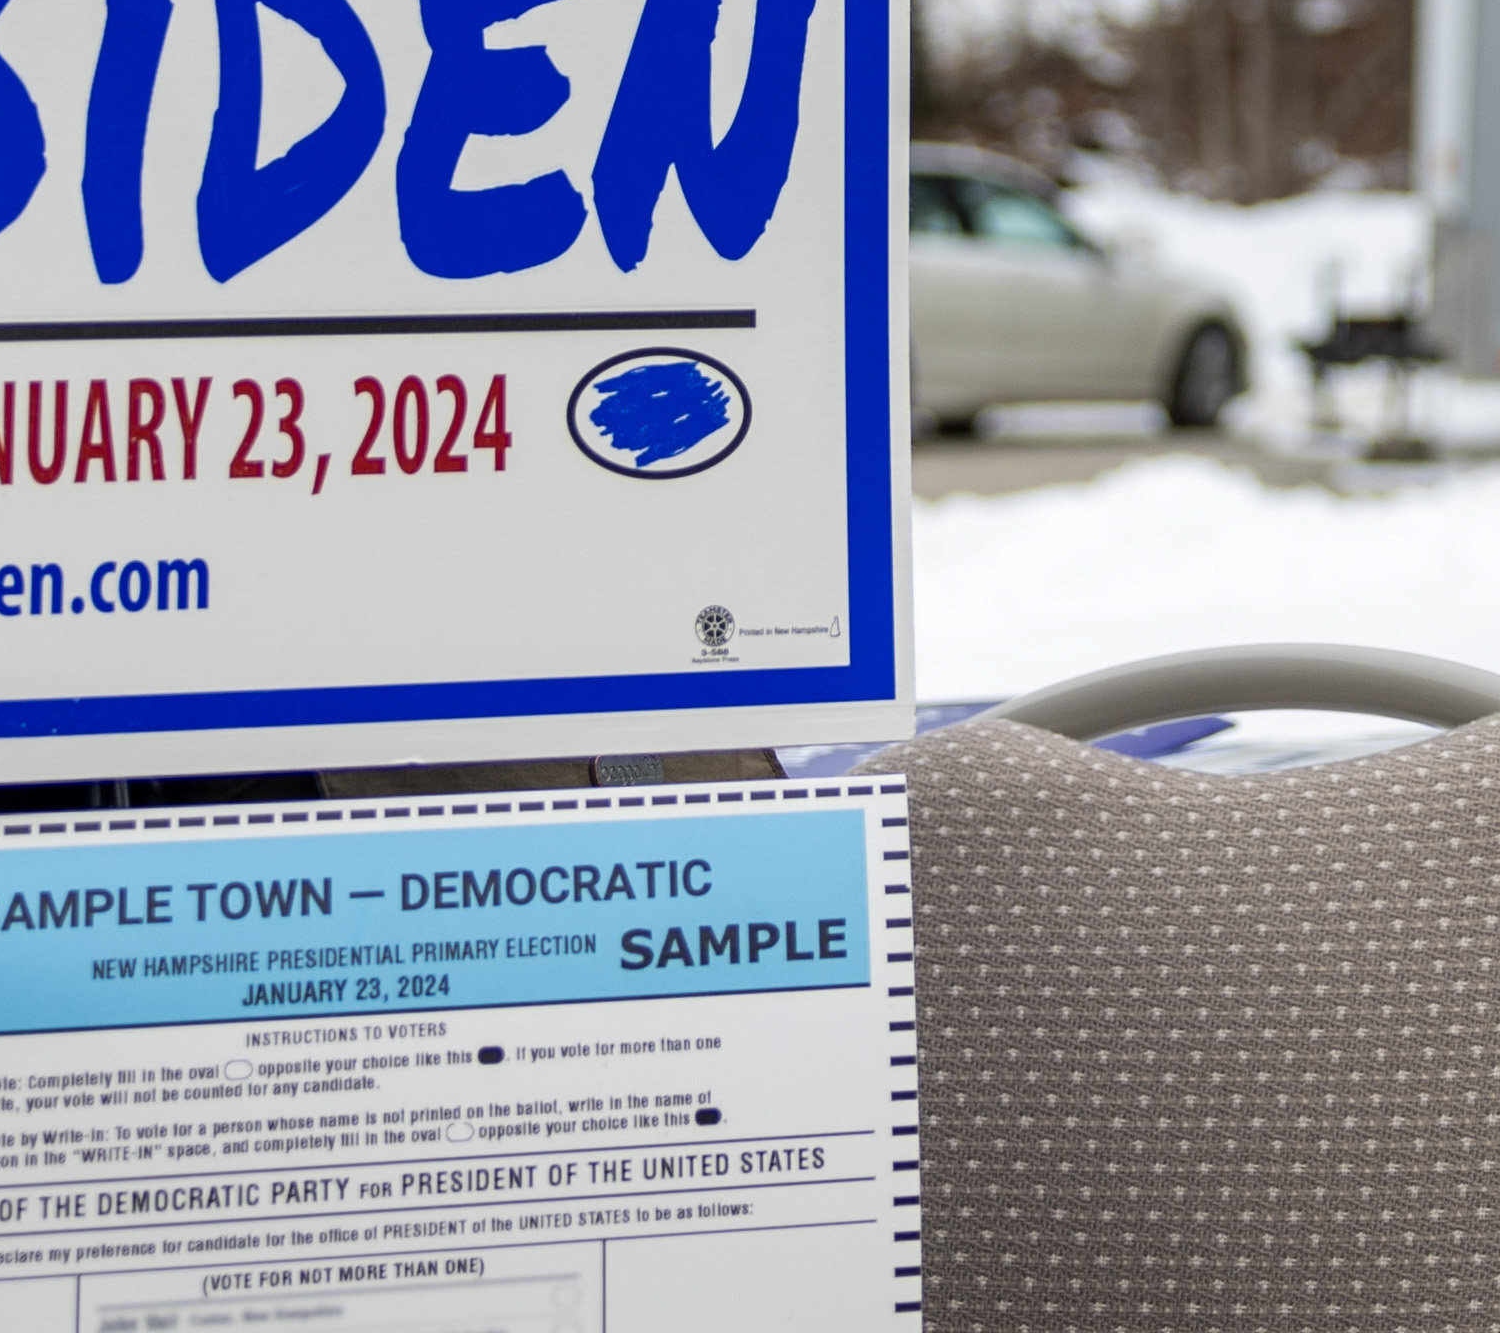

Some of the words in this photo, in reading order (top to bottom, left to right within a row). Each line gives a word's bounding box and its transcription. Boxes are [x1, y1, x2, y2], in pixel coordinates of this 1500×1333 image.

[228, 377, 331, 495] 23,
[351, 374, 512, 476] 2024
[739, 628, 764, 636] Printed
[774, 627, 790, 635] New
[791, 626, 829, 635] Hampshire
[186, 877, 332, 922] TOWN
[401, 858, 712, 912] DEMOCRATIC
[92, 958, 137, 980] NEW
[144, 951, 259, 977] HAMPSHIRE
[267, 944, 405, 971] PRESIDENTIAL
[411, 938, 500, 963] PRIMARY
[506, 933, 597, 959] ELECTION
[620, 917, 848, 971] SAMPLE
[241, 978, 348, 1007] JANUARY
[355, 977, 389, 1003] 23,
[397, 974, 450, 999] 2024
[246, 1027, 358, 1048] INSTRUCTIONS
[363, 1025, 383, 1041] TO
[387, 1022, 447, 1040] VOTERS
[39, 1193, 86, 1220] THE
[97, 1183, 259, 1216] DEMOCRATIC
[271, 1177, 350, 1205] PARTY
[359, 1181, 392, 1199] FOR
[401, 1165, 537, 1196] PRESIDENT
[548, 1162, 578, 1187] OF
[587, 1159, 632, 1184] THE
[643, 1153, 729, 1181] UNITED
[740, 1146, 825, 1174] STATES
[202, 1272, 252, 1297] (VOTE
[259, 1270, 293, 1288] FOR
[299, 1267, 333, 1285] NOT
[338, 1263, 387, 1282] MORE
[393, 1260, 438, 1278] THAN
[445, 1257, 485, 1277] ONE)
